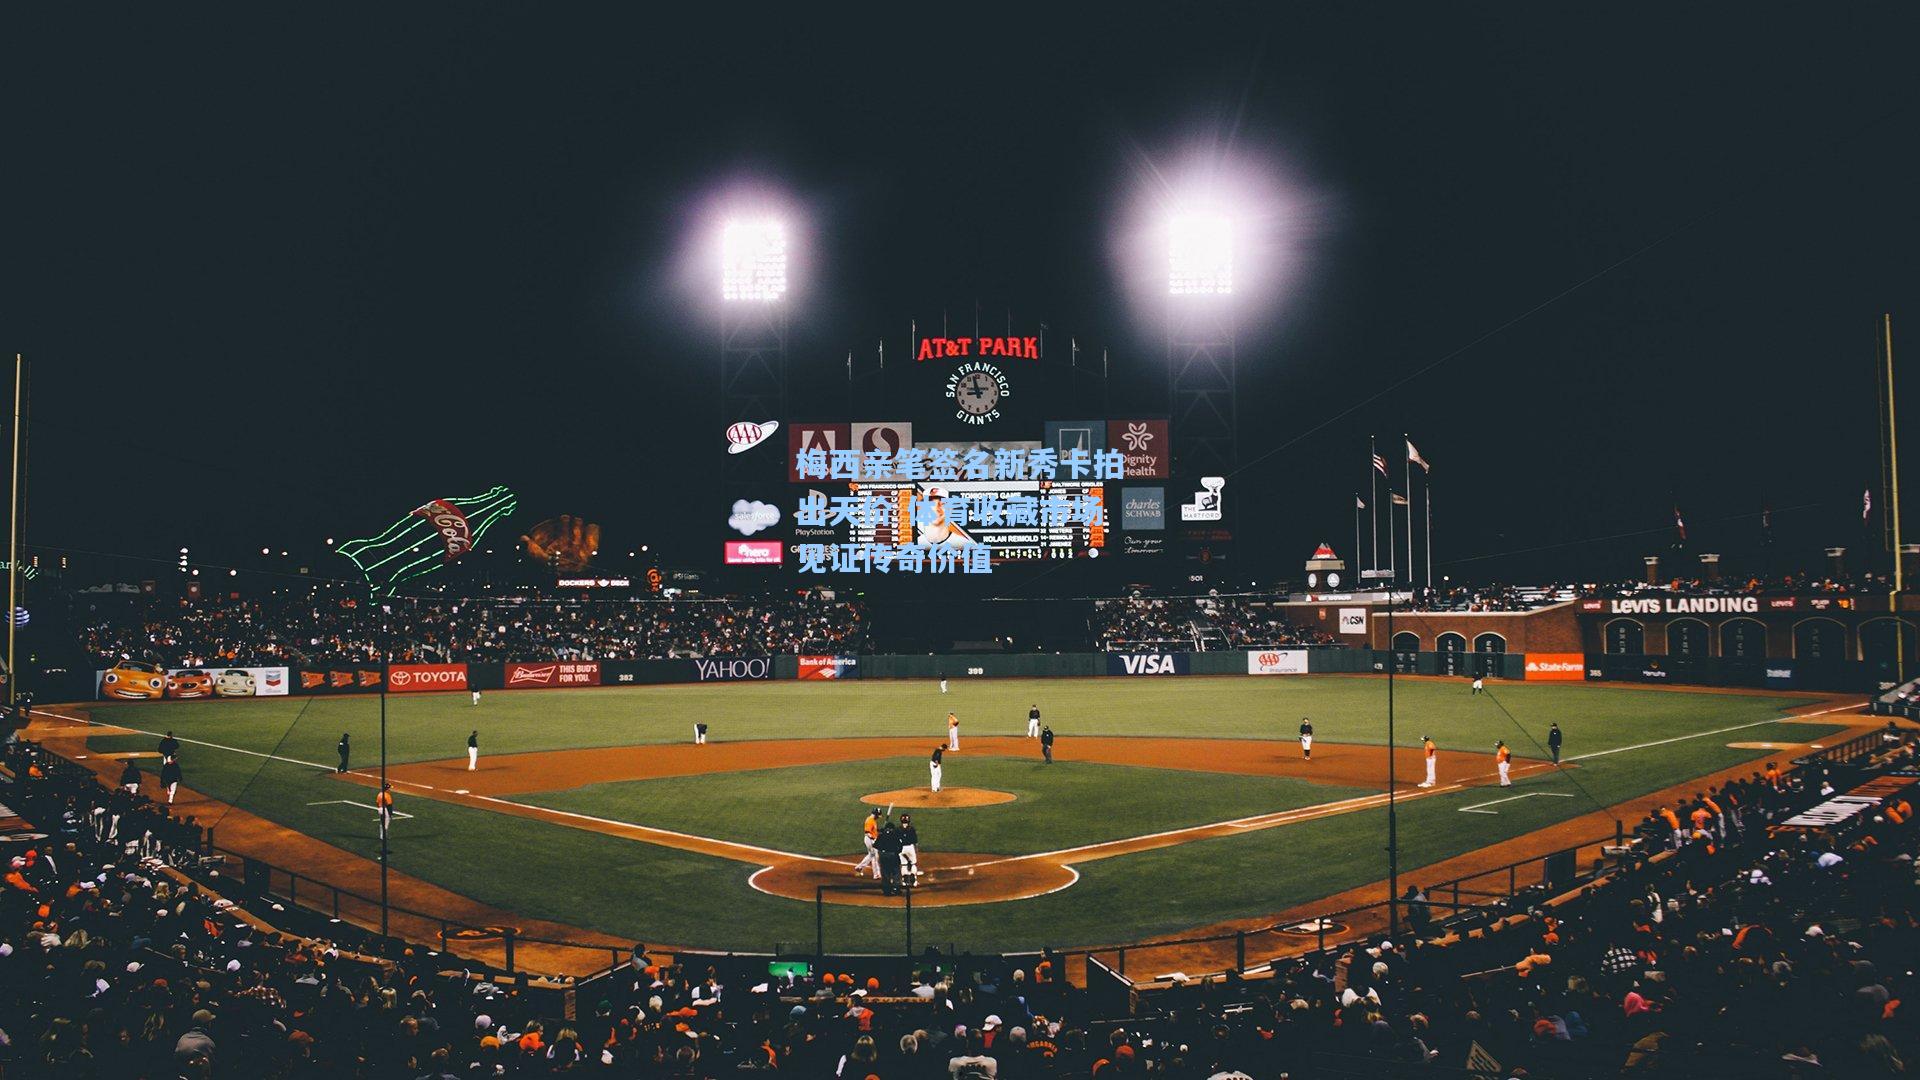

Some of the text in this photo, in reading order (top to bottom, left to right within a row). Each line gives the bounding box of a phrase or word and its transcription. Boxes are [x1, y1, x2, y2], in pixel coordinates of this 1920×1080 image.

[917, 337, 1038, 360] AT&T PARK
[945, 361, 1010, 398] SAN FRANCISCO
[956, 409, 1000, 425] GIANTS
[1126, 499, 1161, 509] charles
[1125, 510, 1162, 518] SCHWAB
[434, 514, 471, 556] Cola
[795, 529, 835, 538] PlayStation
[1666, 598, 1759, 613] LANDING
[1349, 616, 1364, 625] CSN
[800, 658, 856, 666] Bank of America
[1119, 654, 1175, 674] VISA
[559, 664, 598, 674] THIS BUD'S
[695, 658, 770, 680] YAHOO!
[412, 671, 467, 683] TOYOTA
[559, 674, 574, 682] FOR
